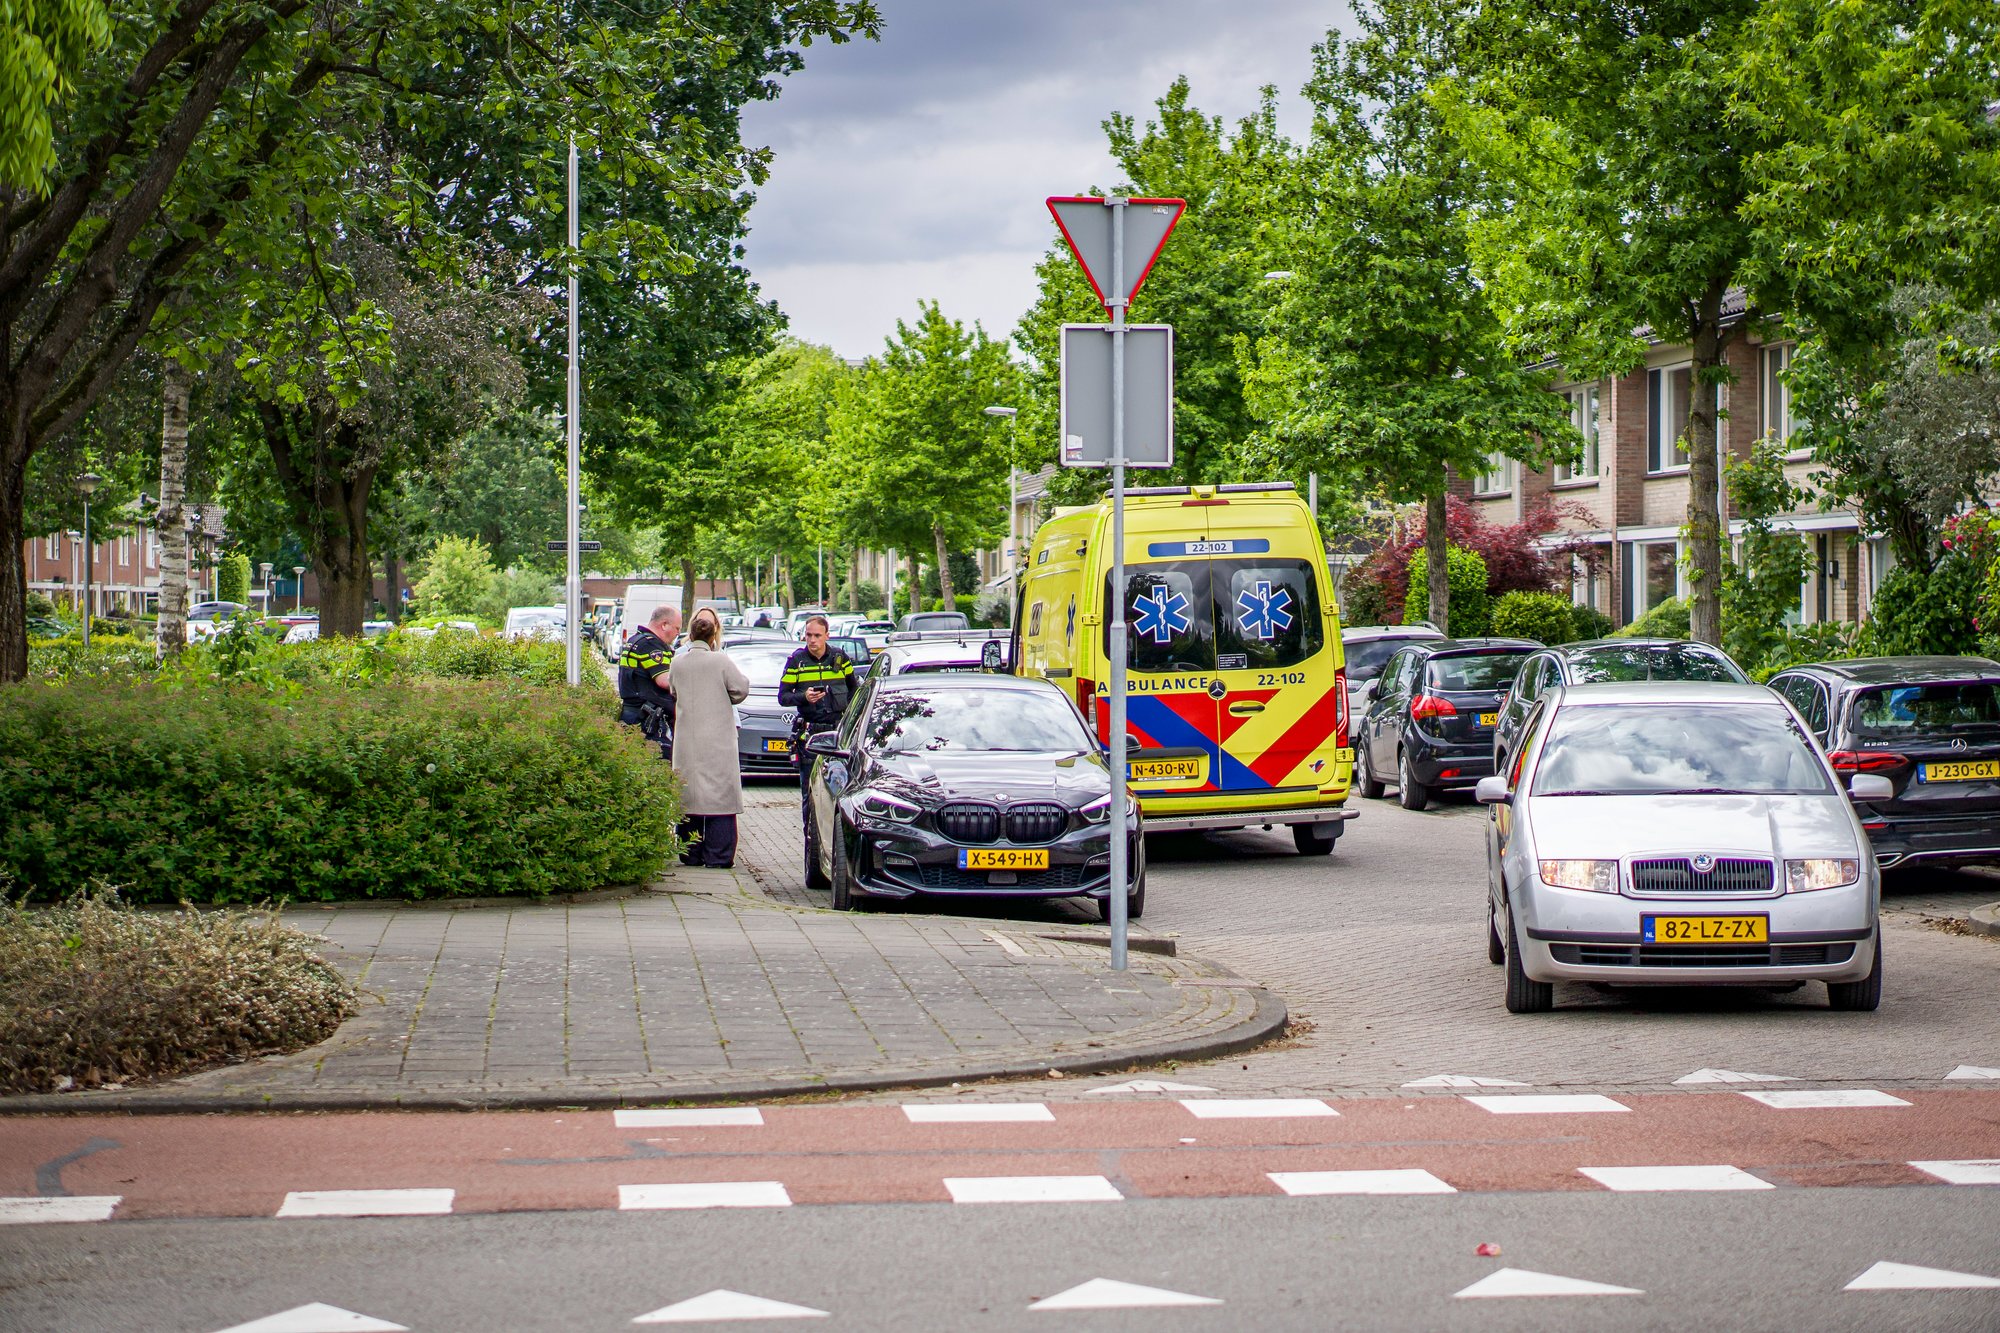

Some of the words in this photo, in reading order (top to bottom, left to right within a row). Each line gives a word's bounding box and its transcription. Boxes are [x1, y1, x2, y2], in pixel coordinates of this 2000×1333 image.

[1192, 542, 1227, 552] 22-102
[1097, 677, 1208, 693] ABULANCE
[1257, 672, 1306, 686] 22-102
[1135, 762, 1194, 776] N-430-RV
[1931, 763, 1994, 778] J-230-GX
[972, 852, 1043, 866] X-549-HX
[1665, 920, 1757, 938] 82-LZ-ZX
